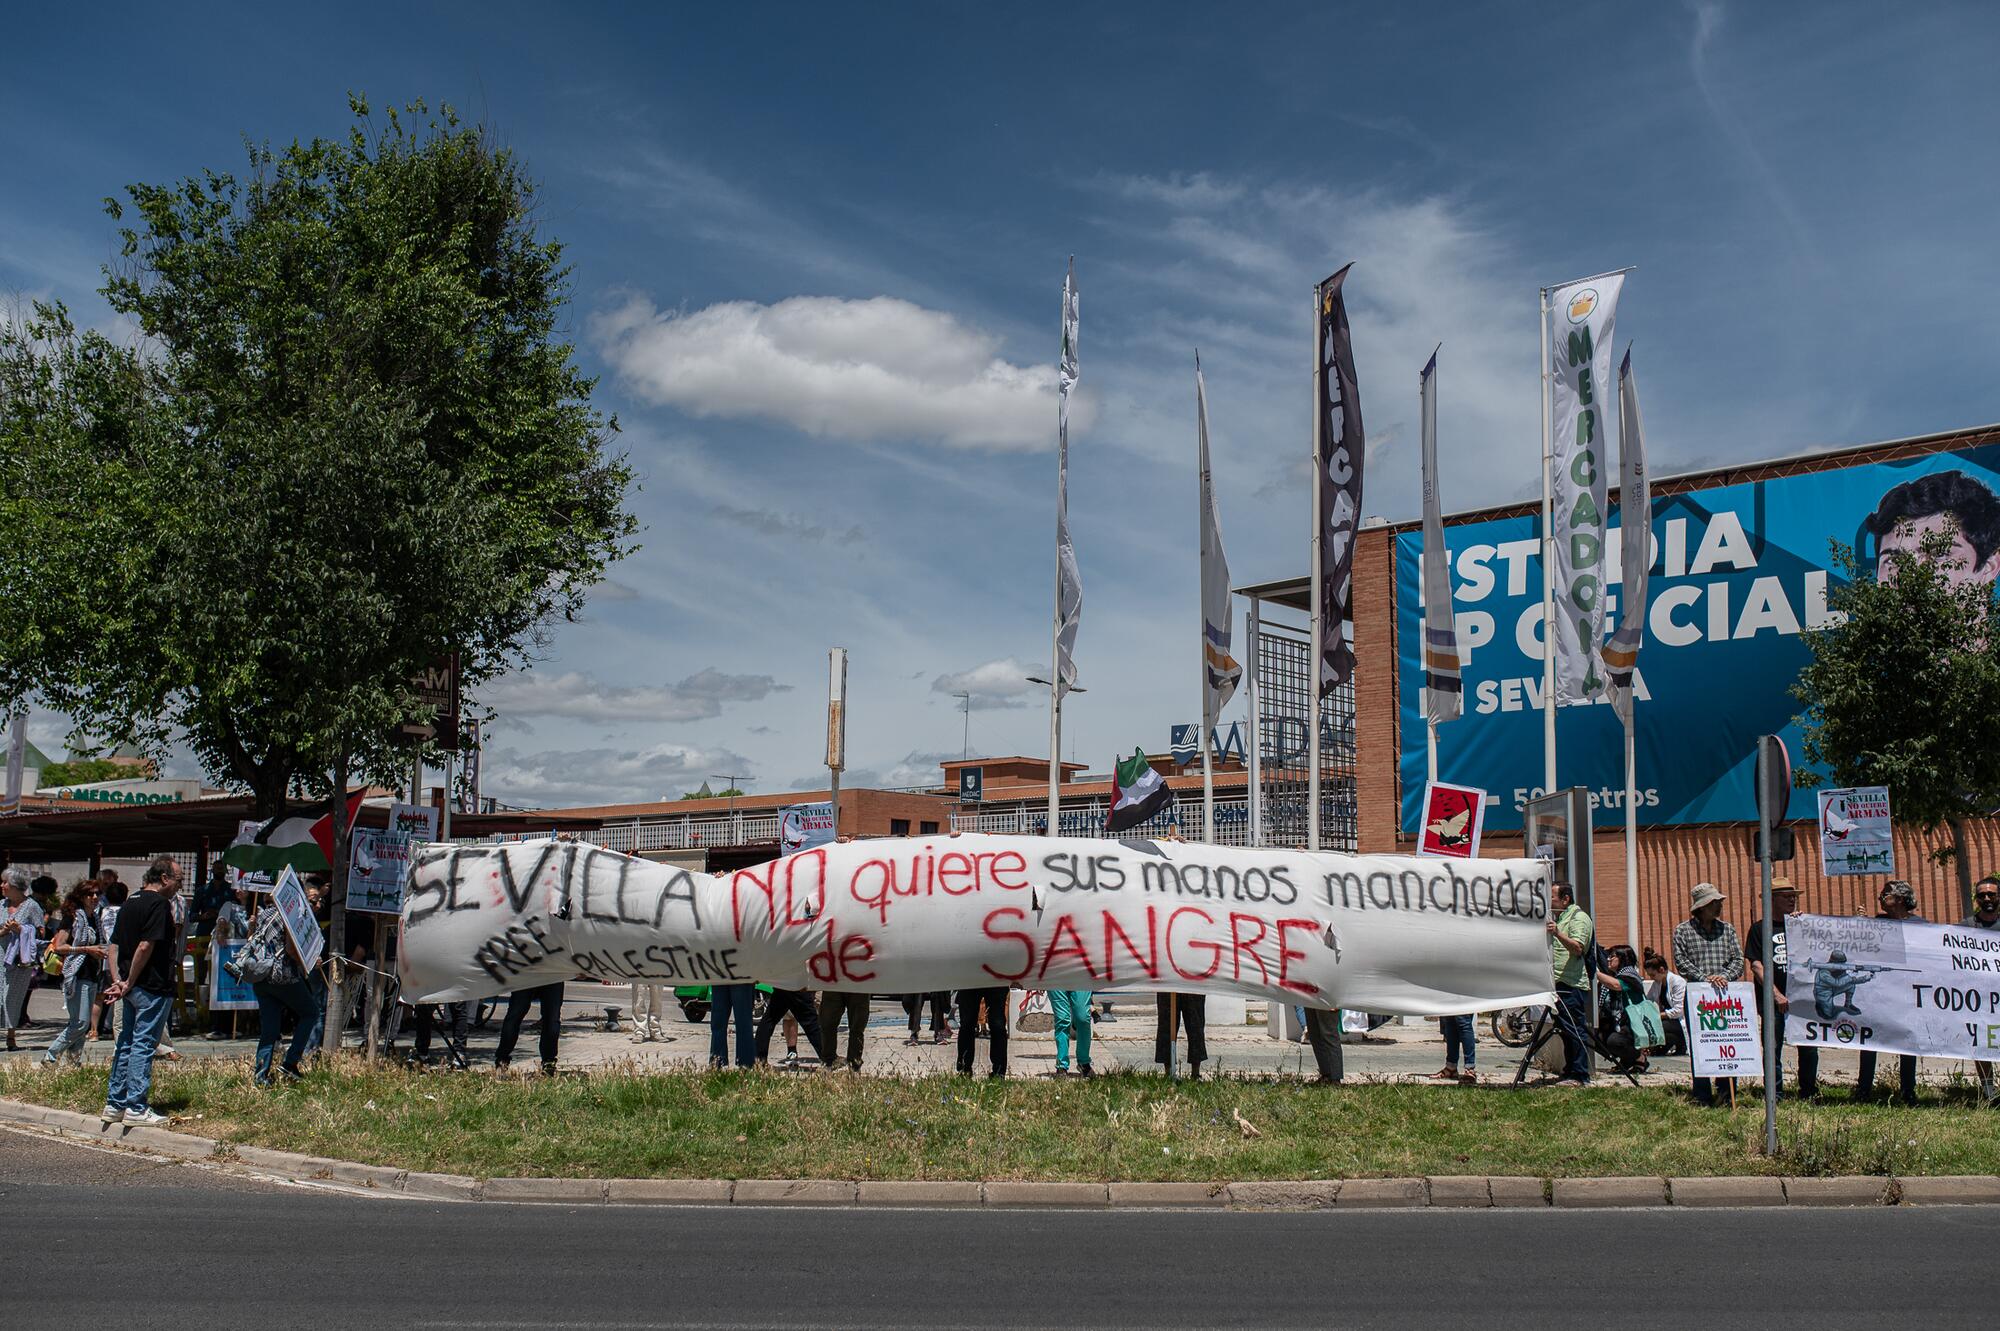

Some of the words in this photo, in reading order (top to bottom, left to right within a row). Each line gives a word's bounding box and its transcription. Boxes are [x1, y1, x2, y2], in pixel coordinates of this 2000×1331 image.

[1846, 793, 1887, 802] SEVILLA
[800, 809, 832, 817] SEVILLA
[1847, 802, 1859, 810] NO
[1847, 809, 1888, 819] ARMAS
[800, 821, 833, 831] ARMAS
[405, 845, 702, 931] SEVILLA
[732, 848, 827, 943] NO
[850, 845, 1030, 925] quiere
[1043, 852, 1127, 893] sus
[1141, 860, 1299, 905] manos
[1323, 863, 1546, 920] manchadas
[1801, 929, 1833, 941] PARA
[1840, 929, 1875, 940] SALUD
[474, 916, 565, 985] FREE
[570, 944, 752, 981] PALESTINE
[809, 916, 878, 983] de
[981, 905, 1321, 996] SANGRE
[1808, 941, 1881, 953] HOSPITALES
[1951, 954, 1991, 972] NADA
[1912, 984, 1981, 1013] TODO
[1700, 1015, 1728, 1031] NO
[1966, 1022, 1978, 1047] Y
[1719, 1044, 1736, 1059] NO
